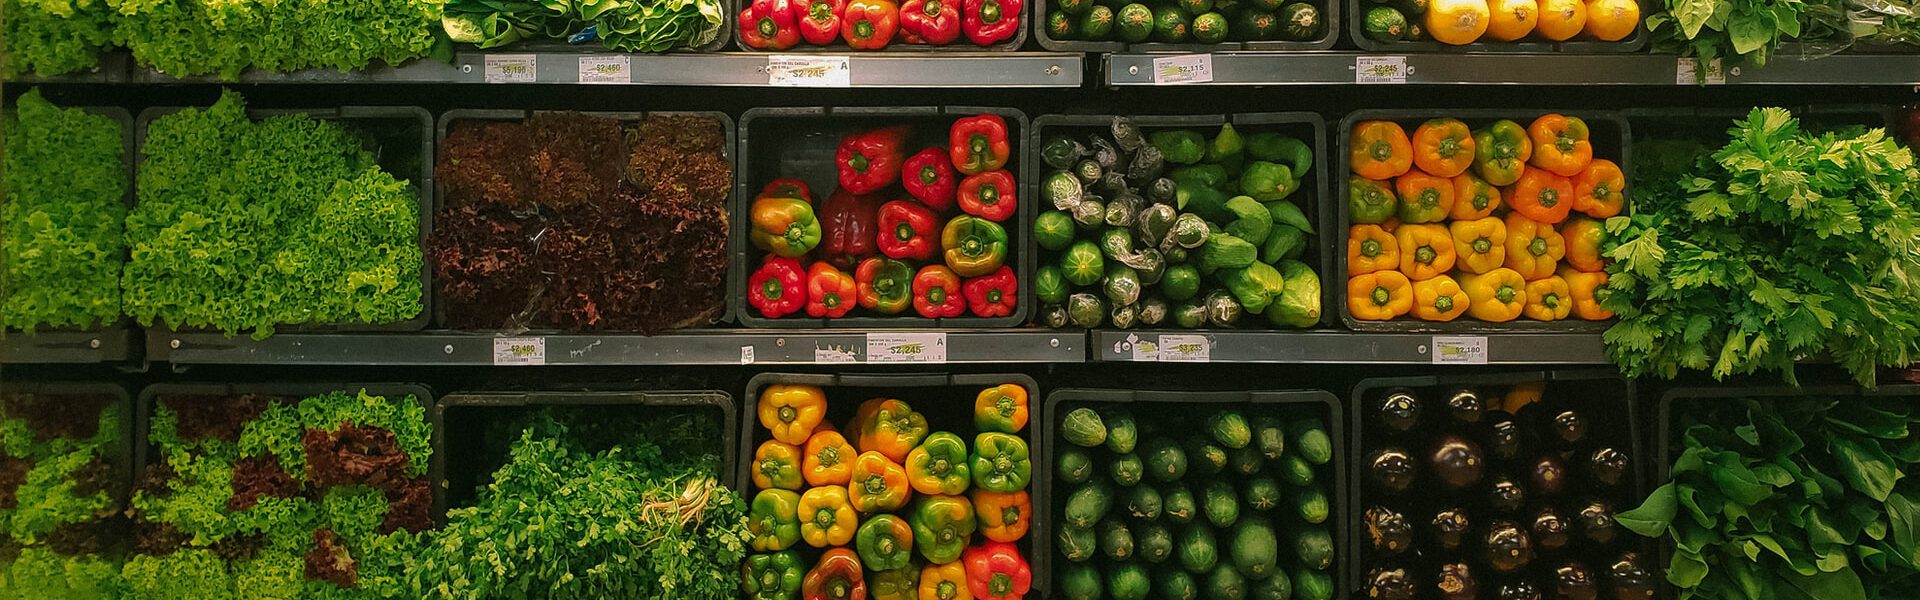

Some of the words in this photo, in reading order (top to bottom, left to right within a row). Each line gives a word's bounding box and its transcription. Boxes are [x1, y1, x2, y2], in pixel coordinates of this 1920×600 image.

[840, 61, 848, 70] A
[937, 338, 944, 346] A
[890, 346, 922, 355] $2,245
